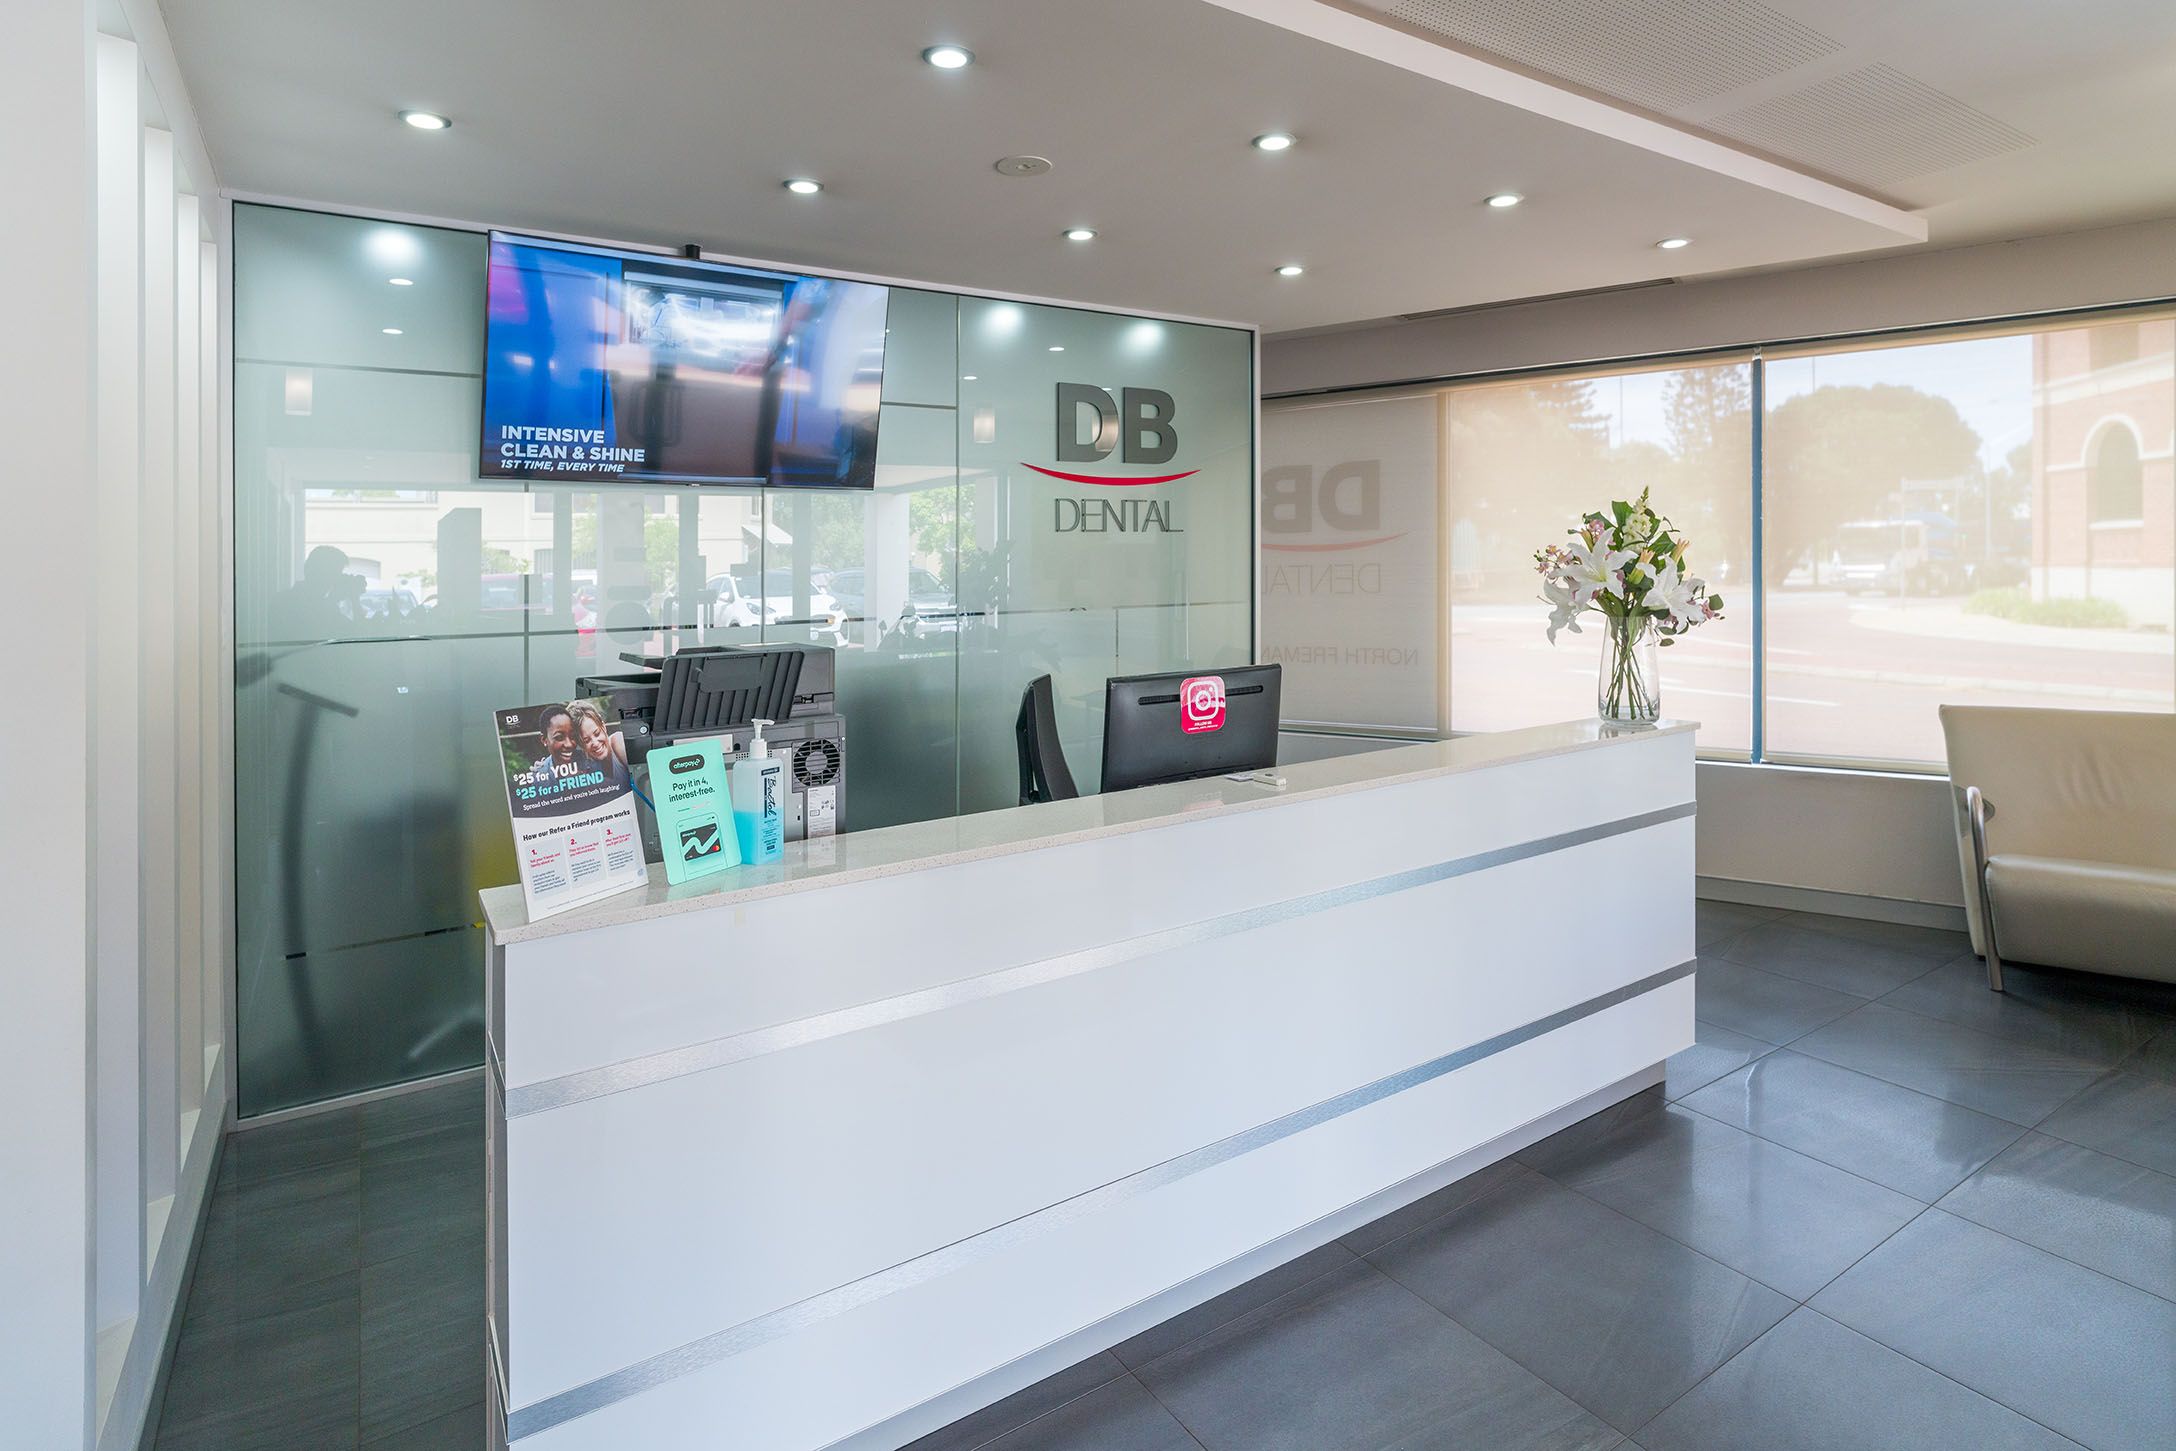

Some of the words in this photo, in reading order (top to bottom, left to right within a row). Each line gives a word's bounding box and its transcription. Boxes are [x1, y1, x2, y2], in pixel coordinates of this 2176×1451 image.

[1057, 382, 1178, 464] DB
[501, 425, 605, 444] INTENSIVE
[500, 443, 567, 460] CLEAN
[572, 447, 585, 460] &
[589, 448, 645, 463] SHINE
[501, 459, 521, 469] 1ST
[523, 460, 554, 472] TIME,
[557, 462, 597, 472] EVERY
[598, 463, 625, 473] TIME
[1055, 498, 1184, 533] DENTAL
[505, 715, 519, 723] DB
[513, 772, 534, 785] $25
[535, 772, 549, 781] for
[550, 762, 578, 778] YOU
[672, 782, 687, 791] Pay
[688, 779, 693, 788] it
[701, 777, 708, 785] 4,
[515, 786, 536, 800] $25
[538, 786, 552, 796] for
[553, 785, 559, 793] a
[559, 771, 604, 792] FRIEND
[669, 787, 715, 802] interest-free.
[523, 801, 541, 811] Spread
[588, 788, 599, 796] both
[549, 826, 566, 835] Refer
[571, 820, 590, 829] Friend
[590, 815, 613, 826] program
[613, 809, 630, 818] works
